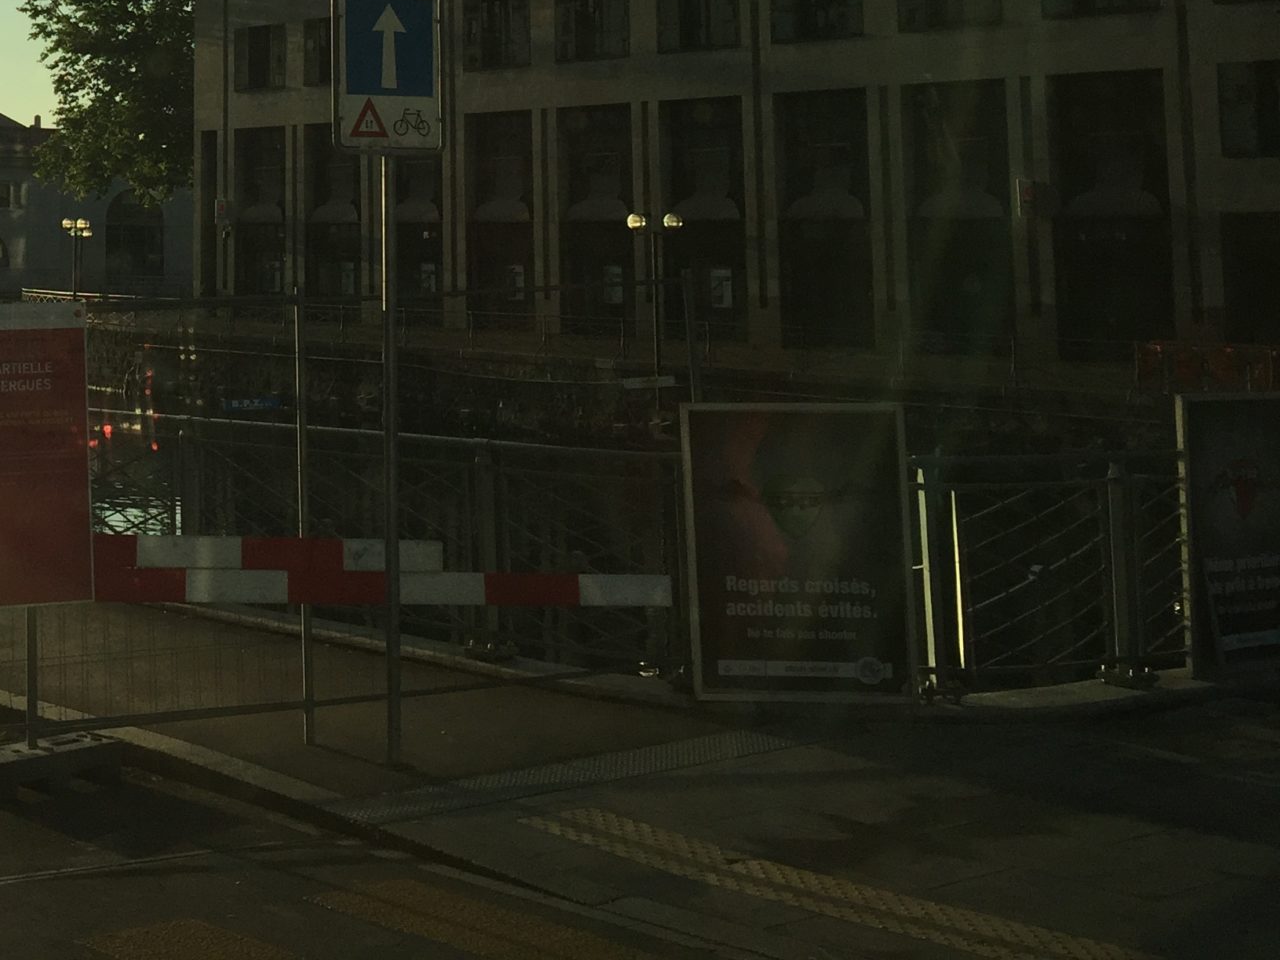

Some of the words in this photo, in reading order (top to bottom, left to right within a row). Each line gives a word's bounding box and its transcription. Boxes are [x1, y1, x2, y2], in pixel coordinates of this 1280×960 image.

[726, 575, 800, 596] Regards
[804, 577, 876, 598] croisés,
[726, 599, 813, 617] accidents
[818, 600, 878, 618] évités.
